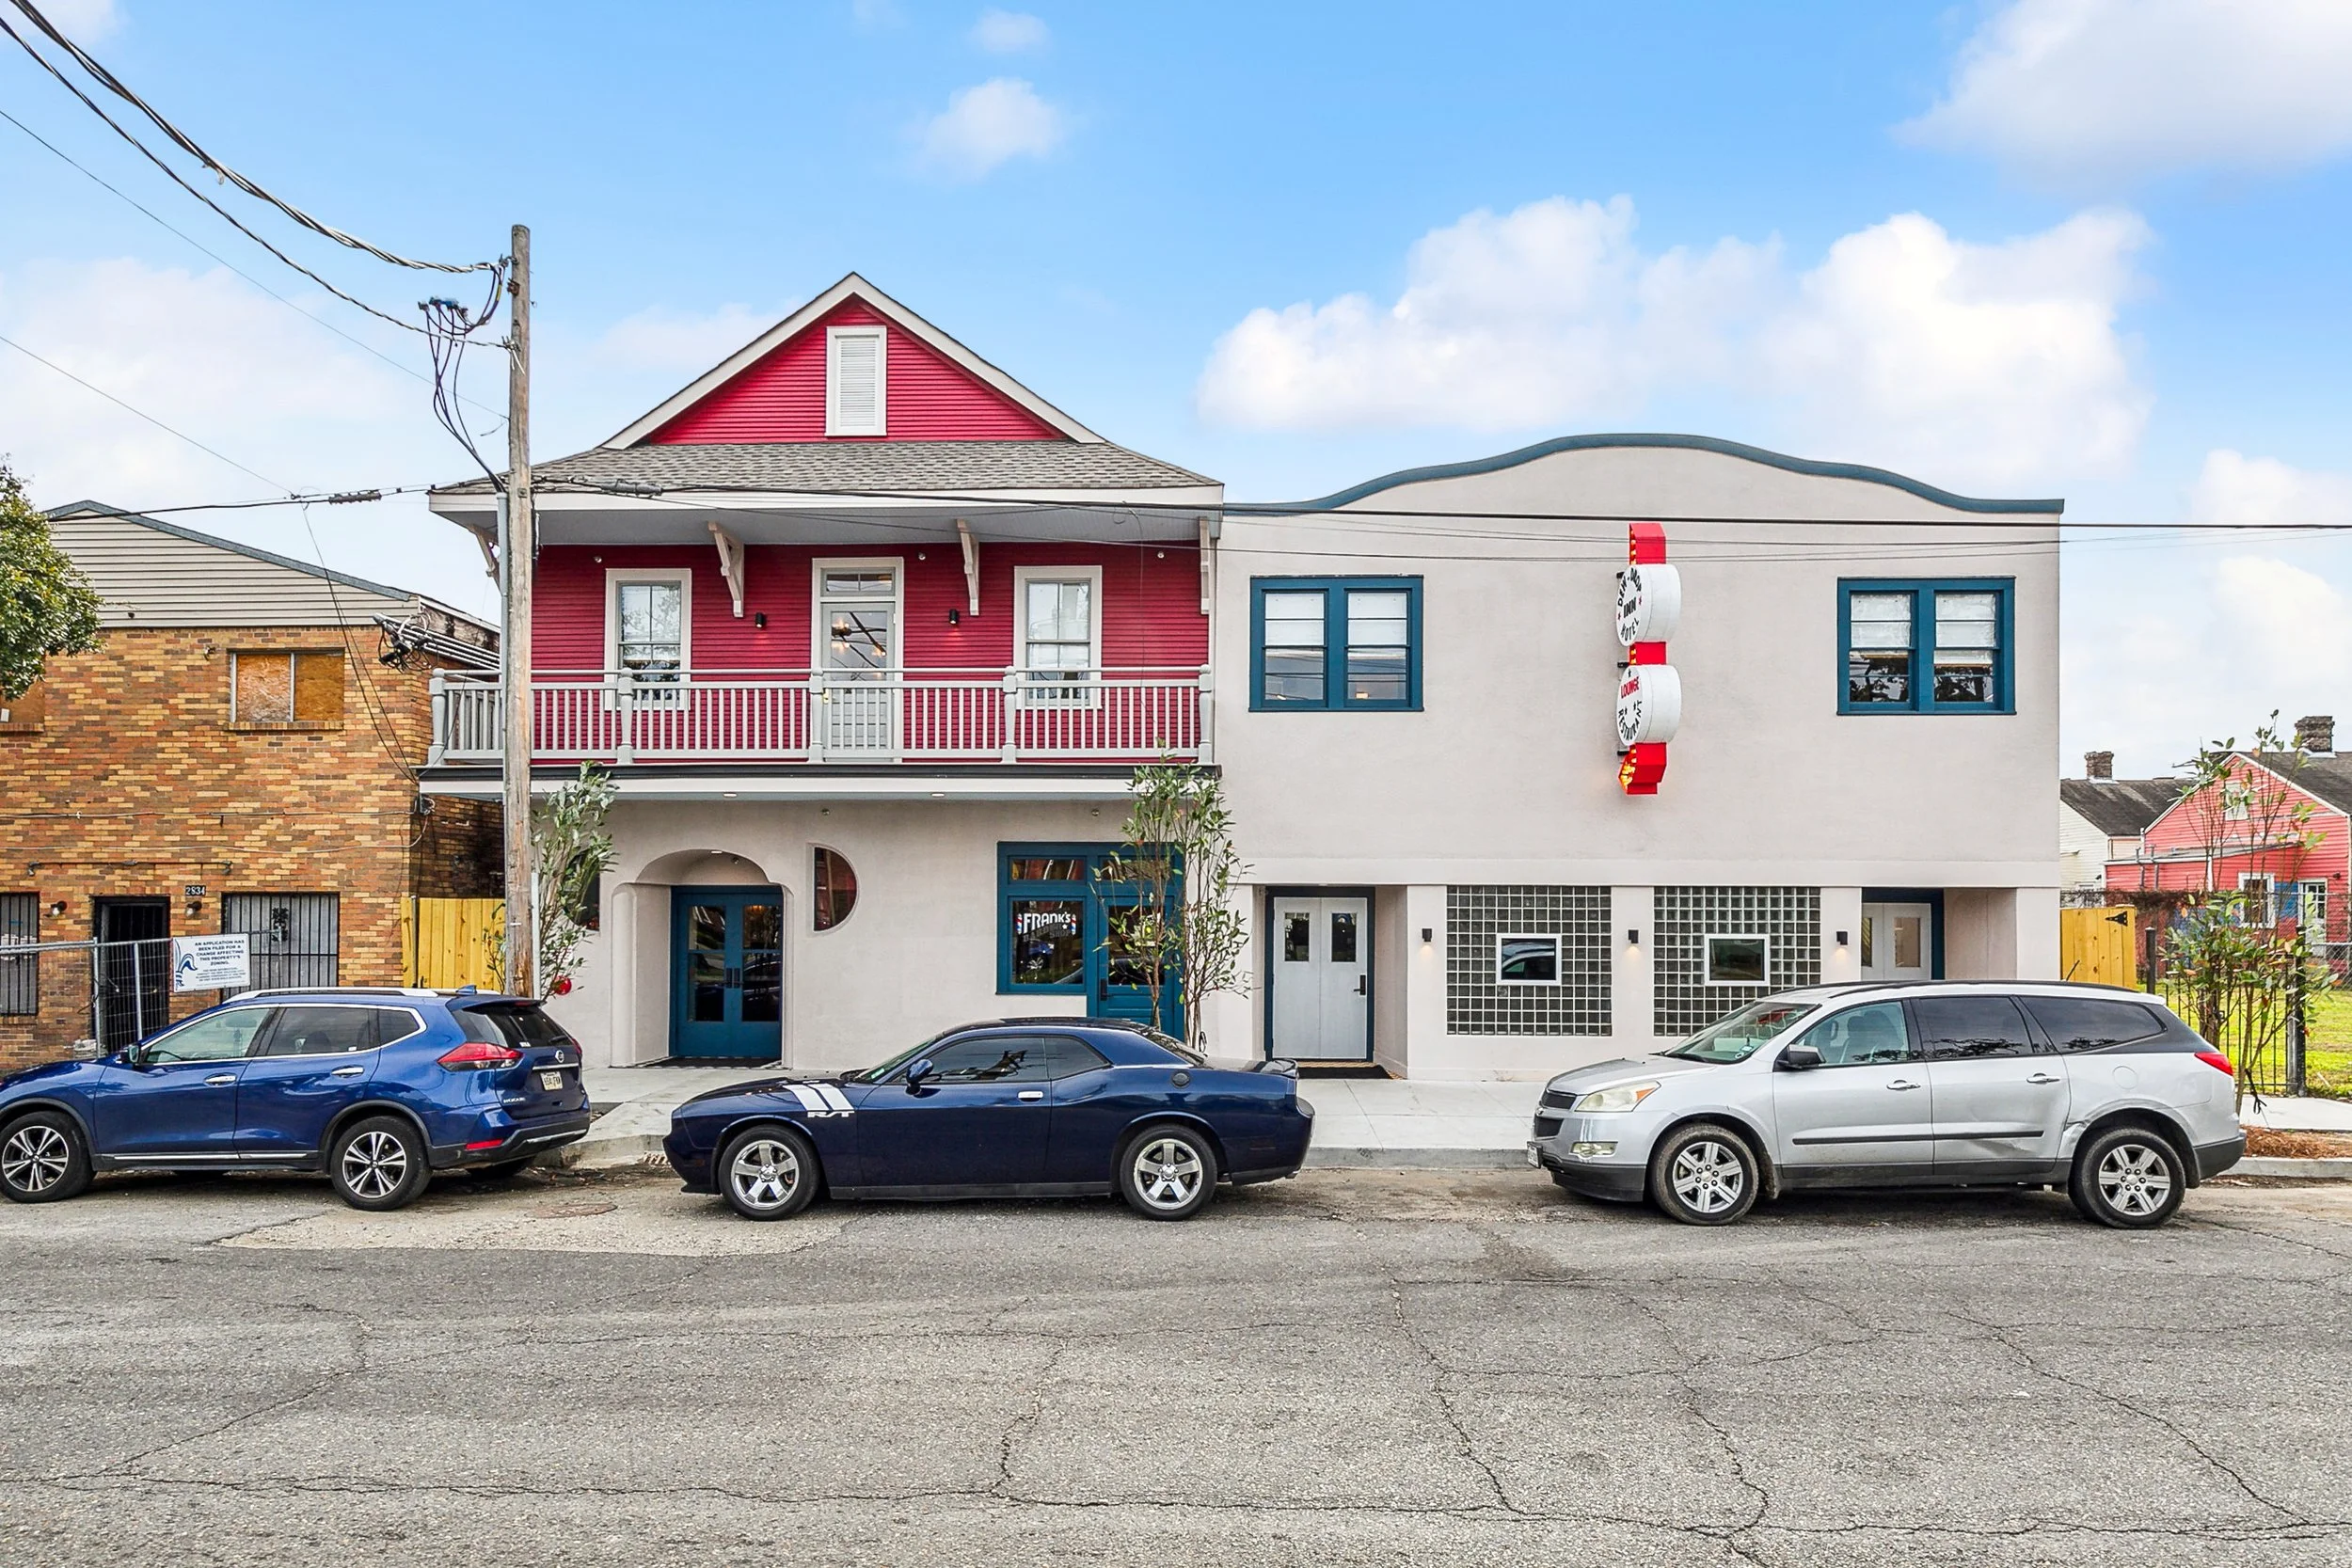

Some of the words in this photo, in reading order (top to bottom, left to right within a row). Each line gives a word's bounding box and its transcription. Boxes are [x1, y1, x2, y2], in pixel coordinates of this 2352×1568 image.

[1623, 596, 1636, 618] INN
[1620, 617, 1640, 641] HOTEL
[1620, 675, 1640, 699] LOUNGE
[1618, 699, 1642, 741] RESTAURANT
[1023, 911, 1072, 935] FRANK'S
